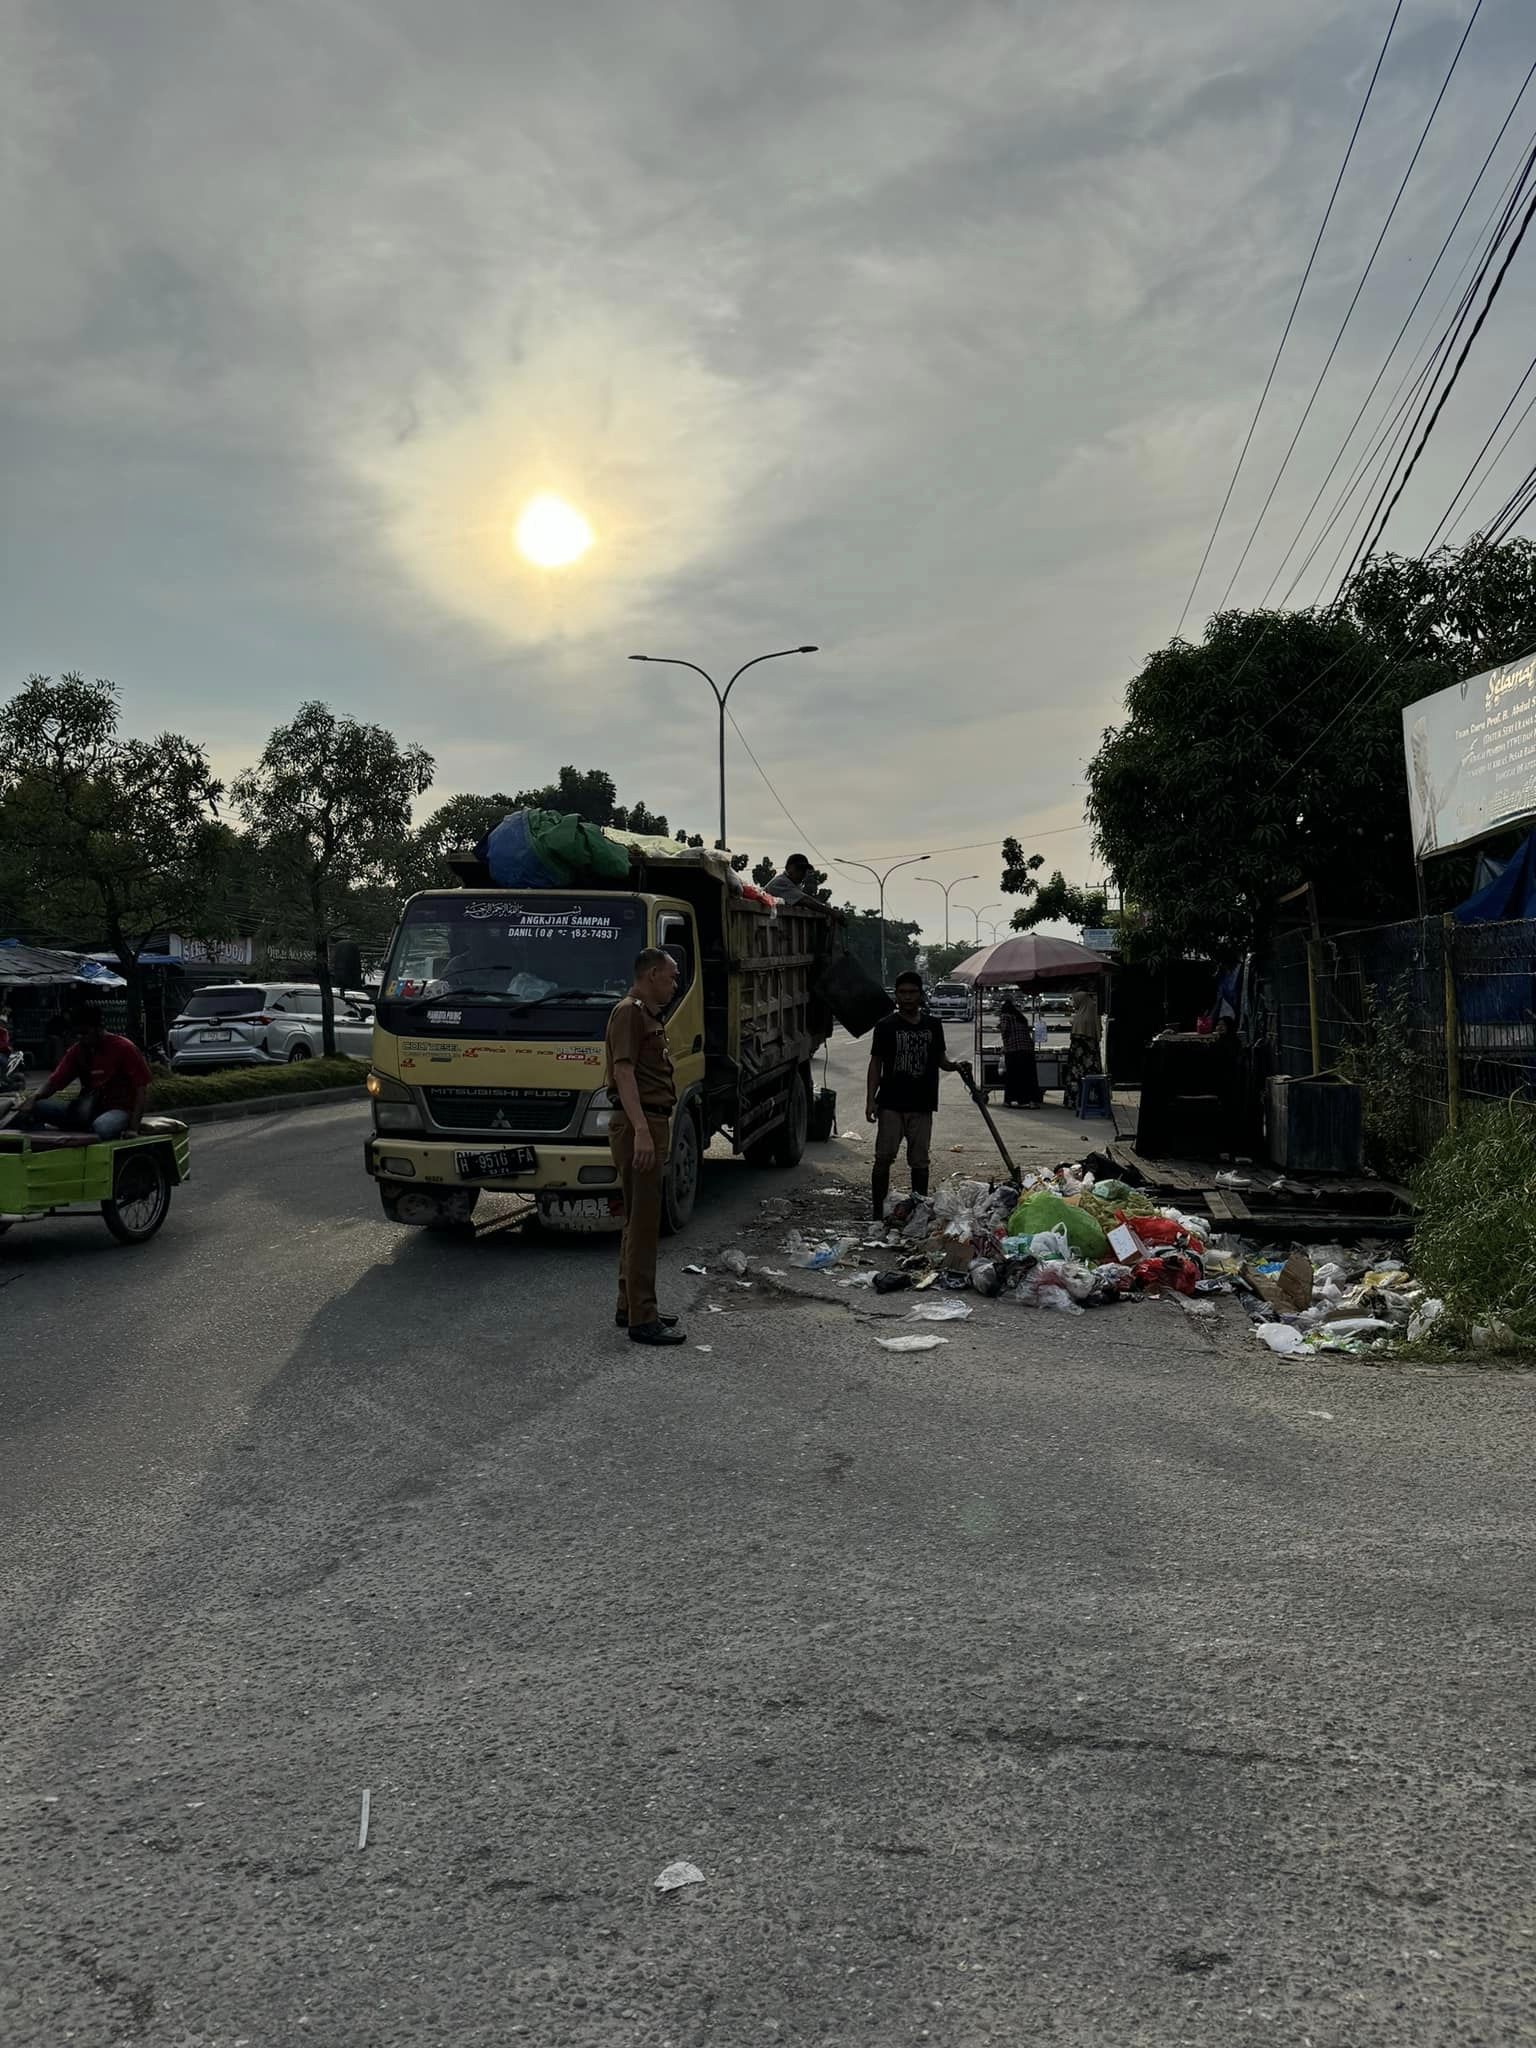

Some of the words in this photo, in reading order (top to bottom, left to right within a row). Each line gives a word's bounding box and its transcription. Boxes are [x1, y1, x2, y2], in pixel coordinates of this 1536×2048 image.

[570, 916, 611, 927] SAMPAH
[508, 927, 533, 937] DANIL
[431, 1087, 519, 1097] MITSUBISHI
[524, 1089, 571, 1098] FUSO
[478, 1152, 509, 1170] 9516
[517, 1147, 535, 1164] FA
